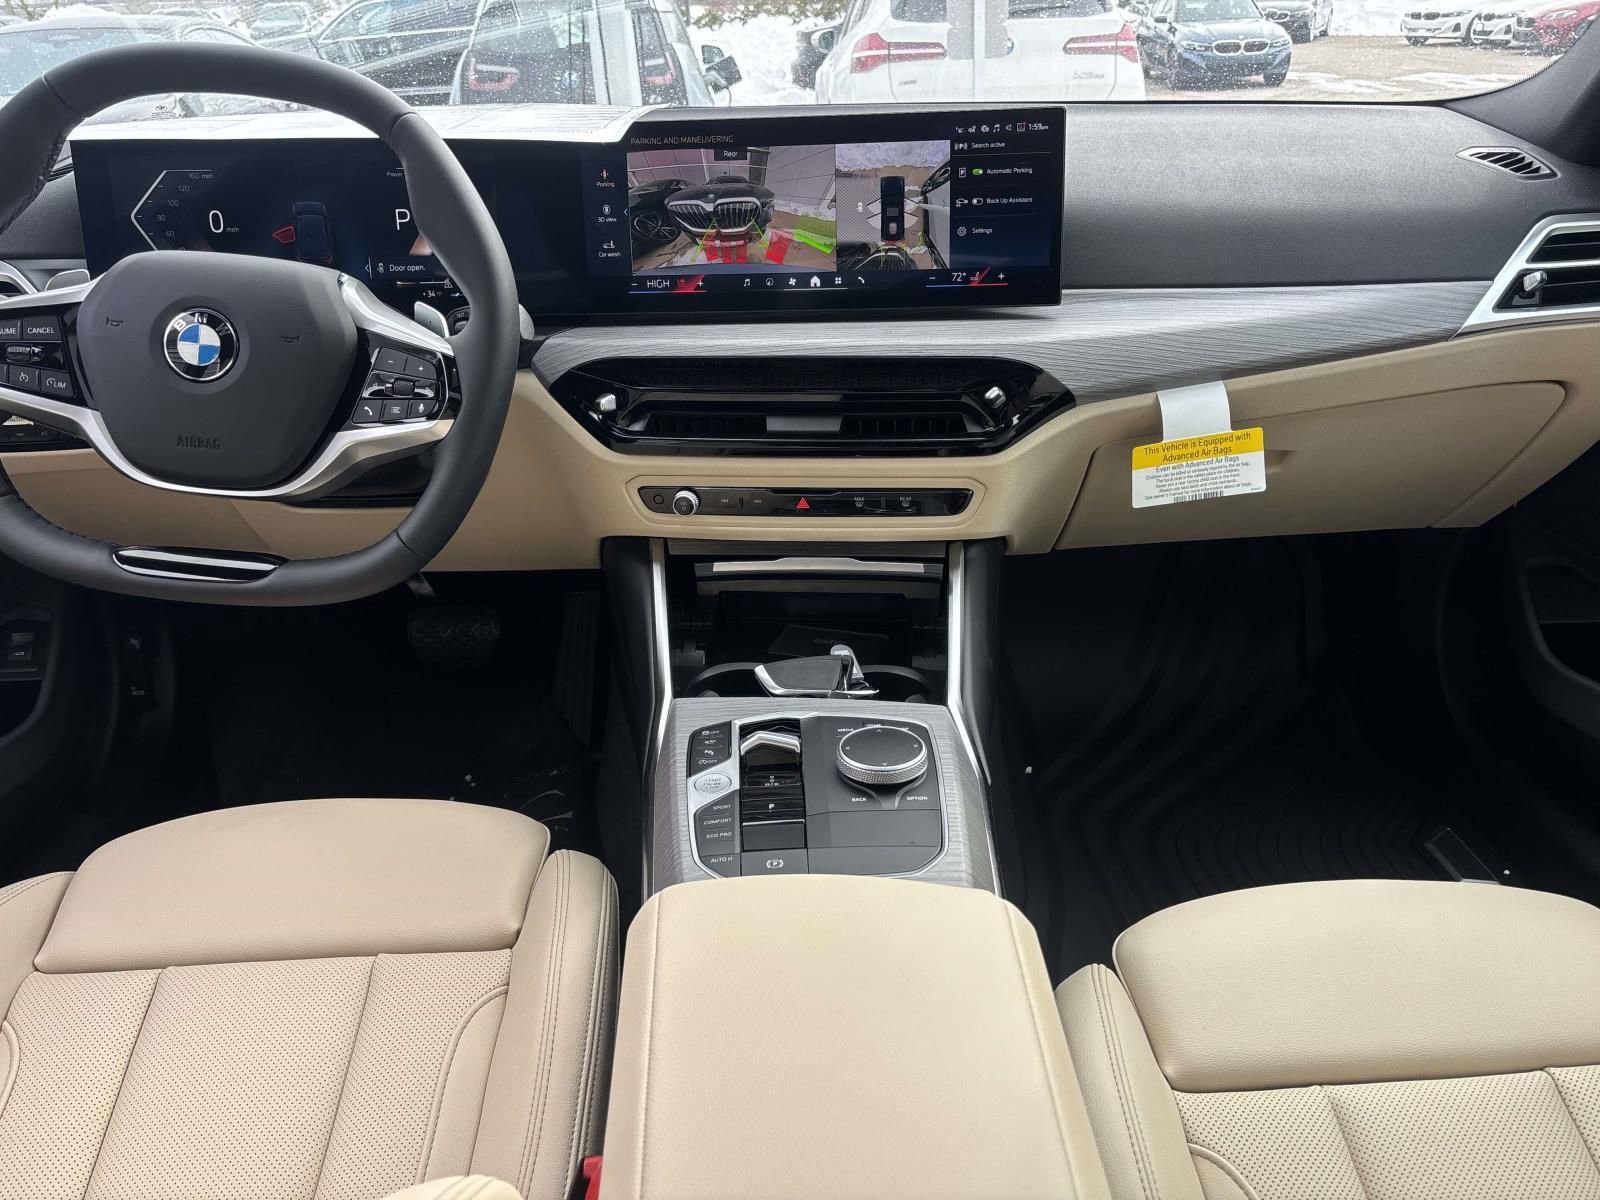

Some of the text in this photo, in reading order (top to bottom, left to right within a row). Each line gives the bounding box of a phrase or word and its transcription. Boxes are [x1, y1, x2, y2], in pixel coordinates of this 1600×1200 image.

[630, 135, 734, 145] PARKING AND MANEUVERING
[209, 210, 224, 233] 0
[395, 208, 411, 231] P
[389, 263, 426, 274] Door open.
[646, 279, 670, 289] HIGH
[27, 326, 56, 334] CANCEL
[173, 312, 231, 337] BMW
[53, 381, 67, 389] LIM
[176, 435, 220, 450] AIRBAG
[1144, 447, 1158, 455] This
[1161, 442, 1188, 453] Vehicle
[1198, 435, 1232, 448] Equipped
[1234, 432, 1250, 441] with
[1162, 445, 1232, 463] Advanced Air Bags
[1156, 465, 1170, 473] Even
[1185, 459, 1212, 468] Advanced
[1224, 455, 1239, 464] Bags
